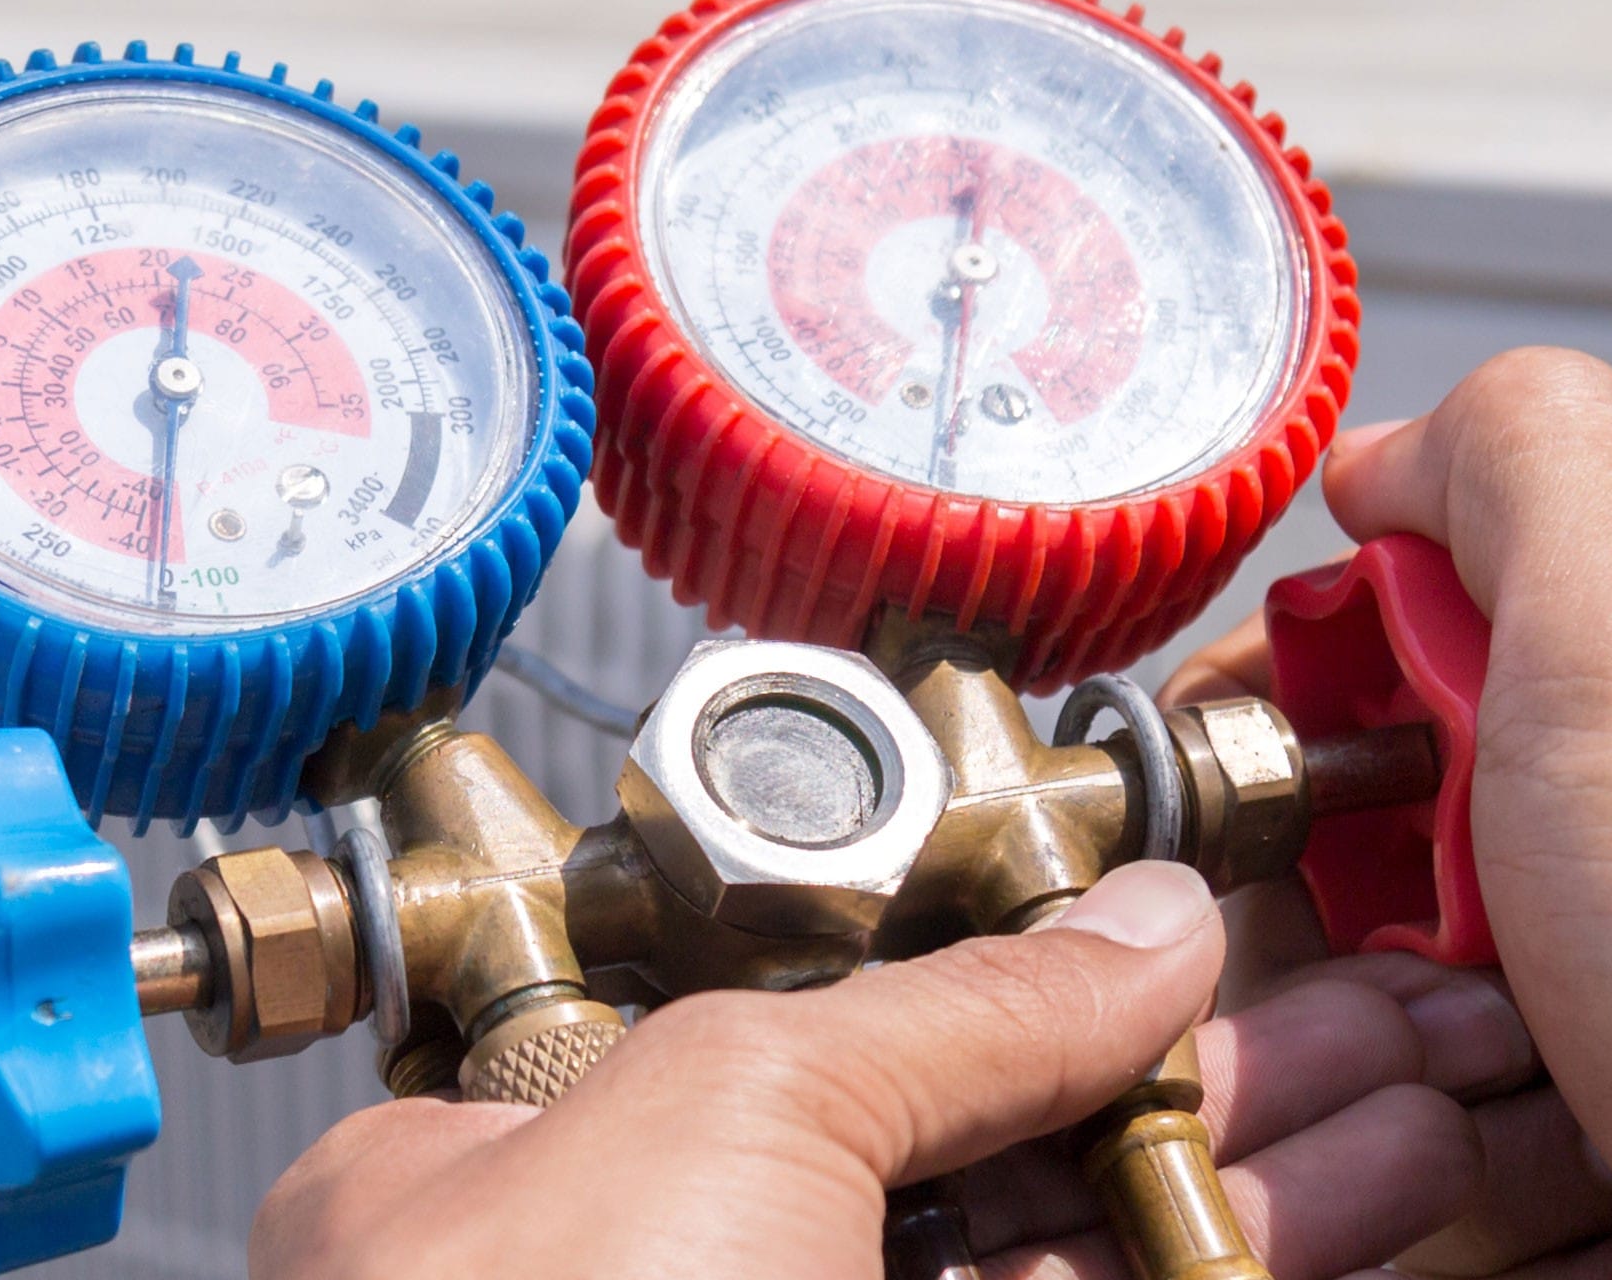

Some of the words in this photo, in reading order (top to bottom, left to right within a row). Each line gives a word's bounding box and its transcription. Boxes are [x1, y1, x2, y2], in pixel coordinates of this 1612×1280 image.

[56, 168, 101, 190] 180
[141, 166, 188, 186] 200
[228, 179, 277, 207] 220
[192, 225, 253, 256] 1500
[306, 214, 354, 247] 240
[65, 258, 96, 282] 15
[139, 249, 170, 268] 20
[221, 263, 256, 289] 25
[375, 263, 417, 301] 260
[13, 288, 42, 313] 10
[301, 274, 355, 320] 1750
[103, 306, 136, 330] 60
[299, 315, 330, 342] 30
[63, 326, 96, 353] 50
[214, 319, 247, 345] 80
[749, 314, 792, 362] 1000
[423, 327, 460, 366] 280
[48, 353, 75, 382] 40
[262, 362, 291, 389] 90
[43, 382, 68, 408] 30
[369, 358, 404, 410] 2000
[340, 393, 365, 420] 35
[448, 396, 474, 434] 300
[821, 389, 868, 424] 500
[29, 489, 68, 518] -20
[337, 475, 384, 526] 3400
[22, 522, 72, 558] 250
[108, 535, 152, 555] -40
[344, 528, 383, 552] kPa
[181, 566, 240, 588] -100
